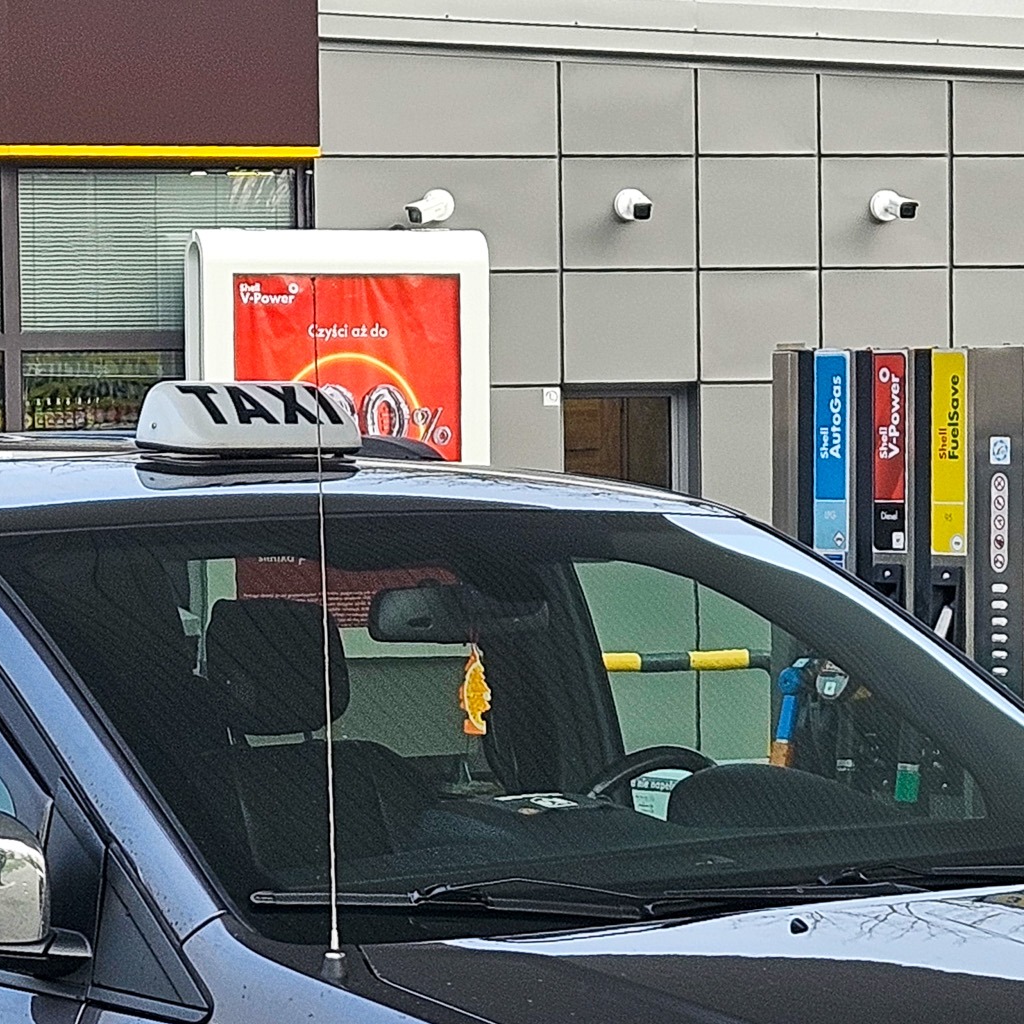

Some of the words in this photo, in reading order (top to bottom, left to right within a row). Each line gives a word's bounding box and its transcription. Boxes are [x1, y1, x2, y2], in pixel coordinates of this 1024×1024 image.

[239, 283, 261, 292] Shell
[240, 292, 295, 304] V-Power
[308, 324, 348, 341] Czyści
[351, 324, 368, 337] aż
[370, 323, 388, 337] do
[176, 385, 344, 425] TAXI
[829, 375, 842, 459] AutoGas
[888, 373, 900, 459] V-Power
[948, 374, 960, 460] FuelSave
[820, 427, 829, 459] Shell
[879, 427, 888, 459] Shell
[939, 428, 947, 460] Shell
